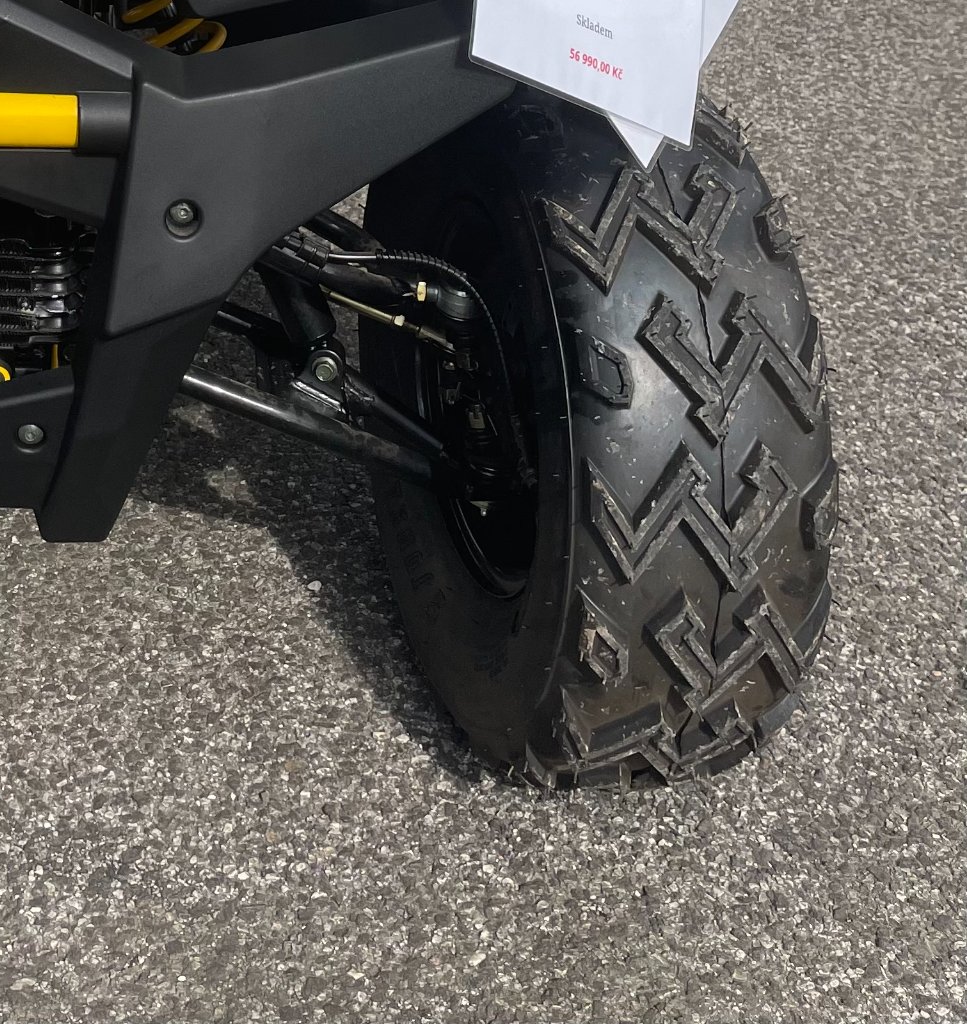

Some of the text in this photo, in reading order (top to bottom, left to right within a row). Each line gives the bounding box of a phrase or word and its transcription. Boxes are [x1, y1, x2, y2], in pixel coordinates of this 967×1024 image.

[576, 14, 613, 39] Skladem
[569, 48, 623, 80] 56 990,00 Kč
